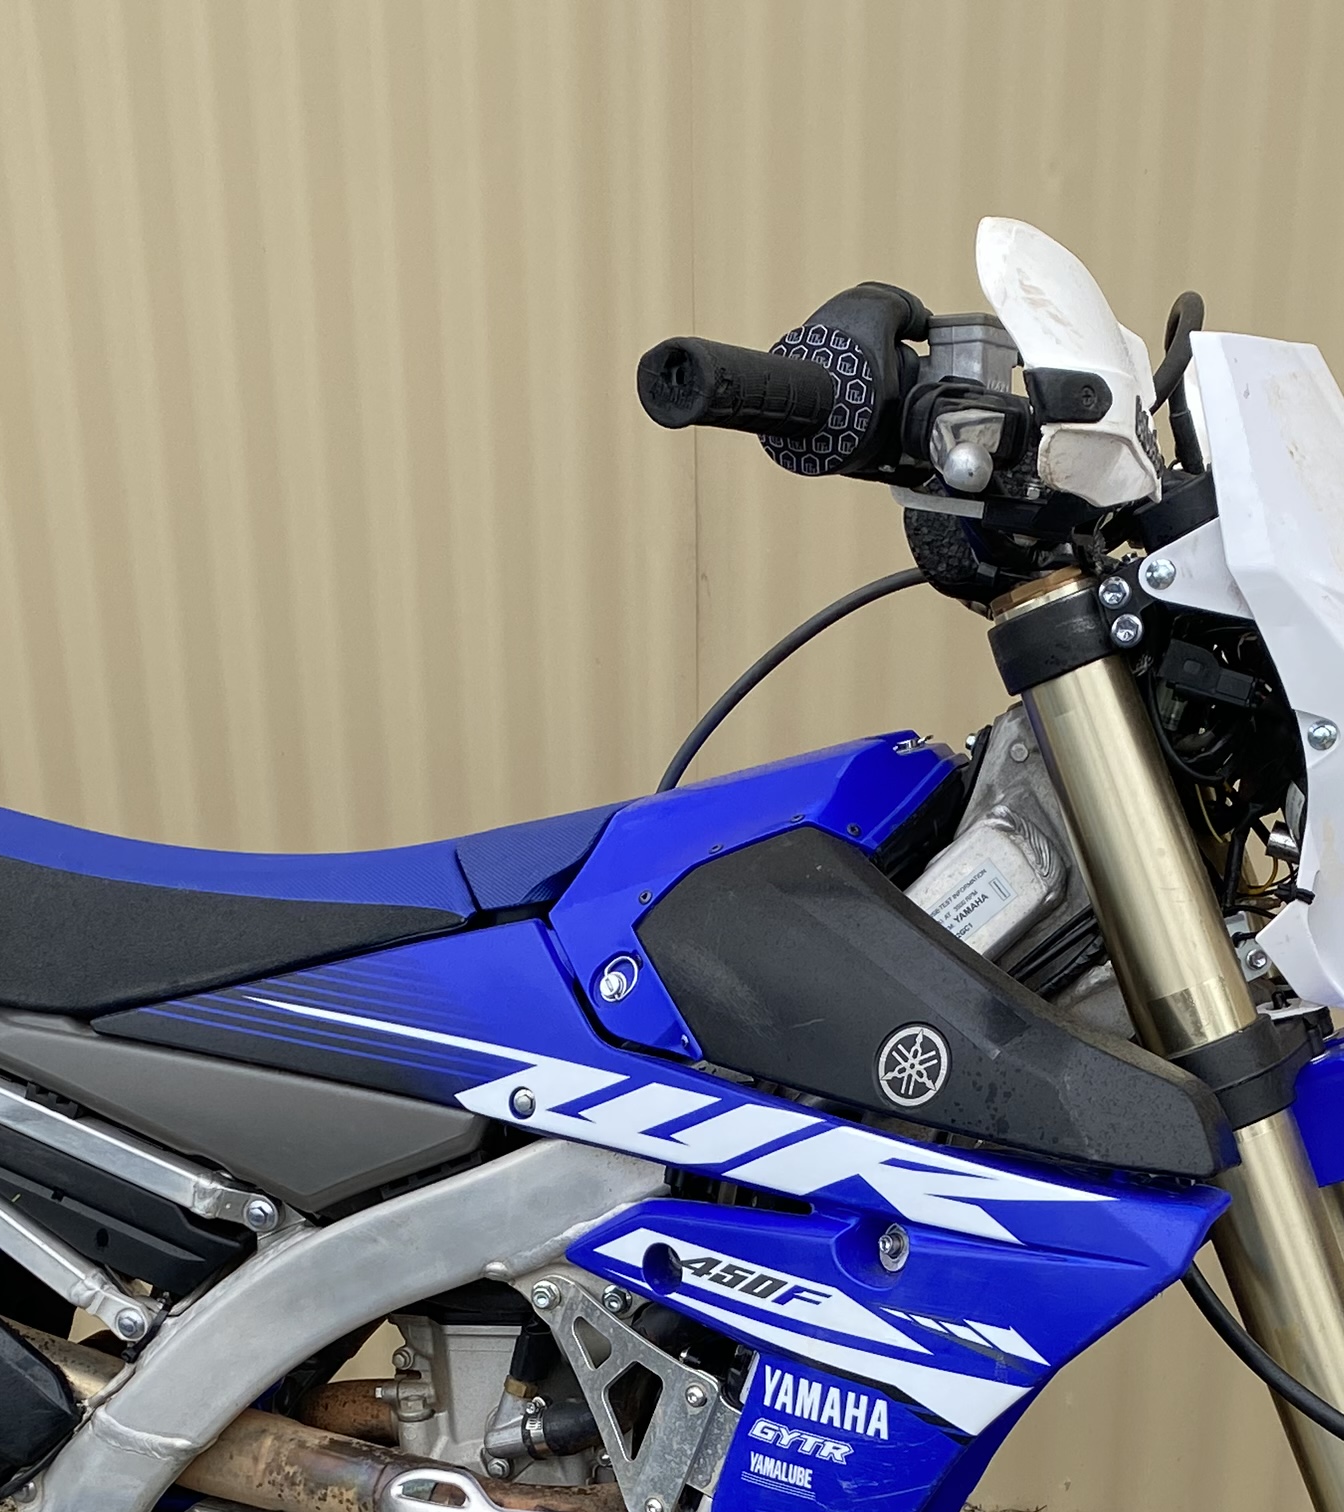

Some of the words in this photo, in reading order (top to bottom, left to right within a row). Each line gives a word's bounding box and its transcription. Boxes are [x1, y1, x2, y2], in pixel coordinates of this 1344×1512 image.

[953, 893, 989, 923] YAMAHA
[680, 1256, 833, 1306] 450F
[763, 1364, 889, 1441] YAMAHA
[748, 1417, 854, 1465] GYTR
[749, 1450, 814, 1490] YAMALUBE
